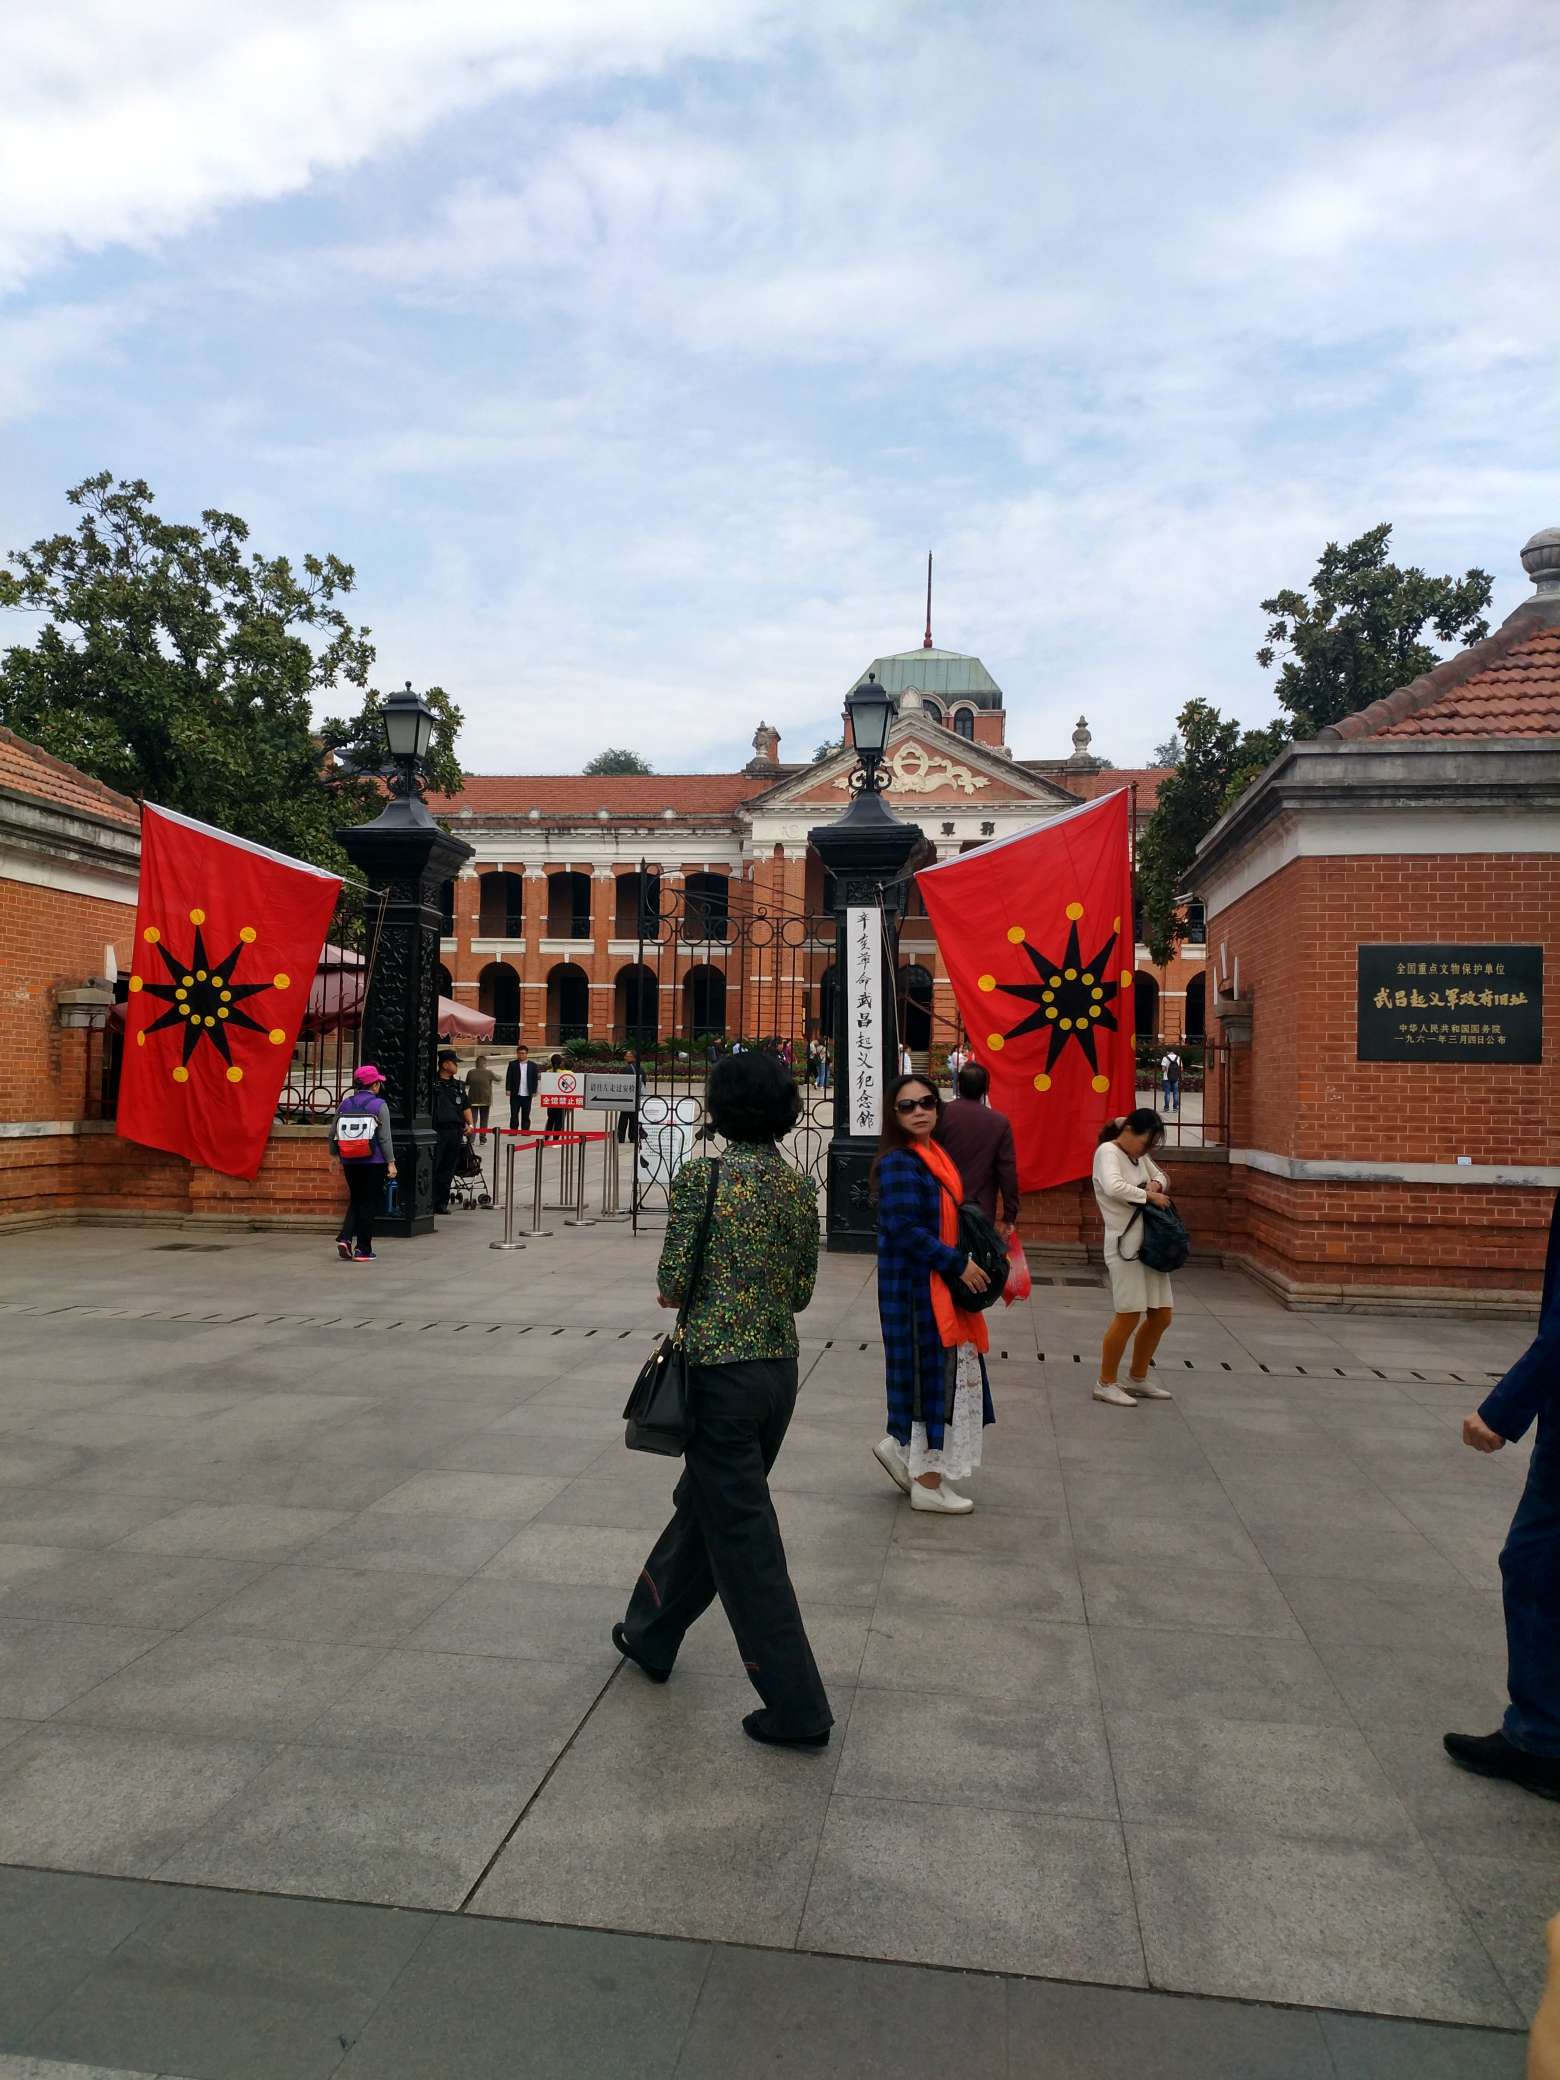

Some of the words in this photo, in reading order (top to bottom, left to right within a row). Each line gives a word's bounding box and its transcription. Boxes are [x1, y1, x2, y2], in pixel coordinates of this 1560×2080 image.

[1396, 962, 1505, 976] 全国重点文物保护单位
[1399, 1024, 1501, 1034] 中华人民共和国国务院
[1393, 1035, 1507, 1045] 一九六一年三月四日公布
